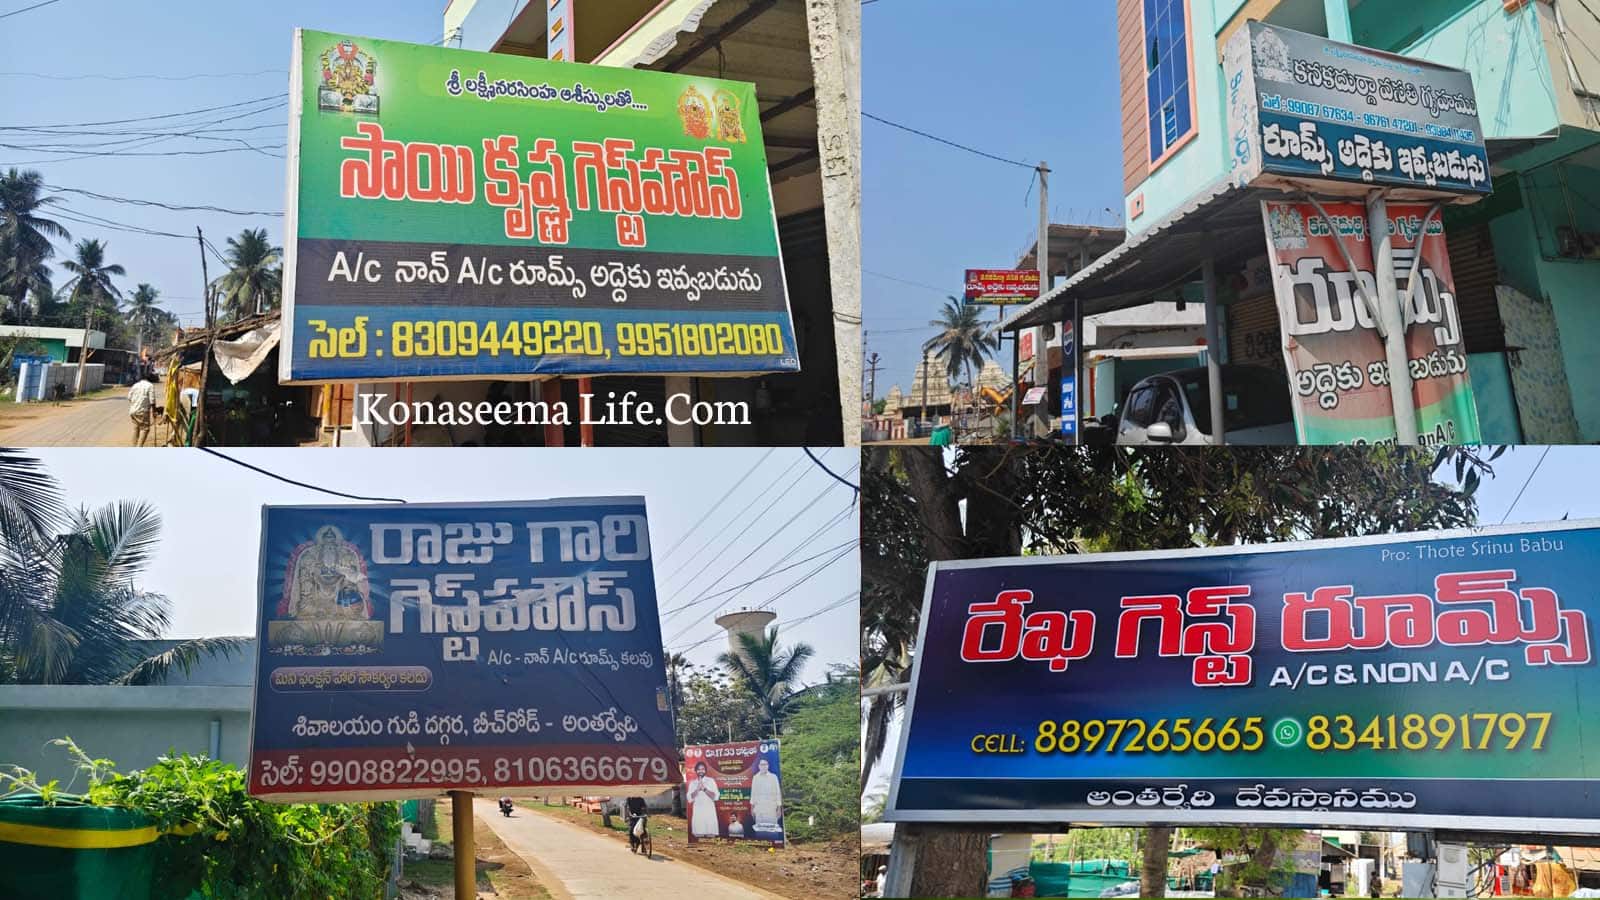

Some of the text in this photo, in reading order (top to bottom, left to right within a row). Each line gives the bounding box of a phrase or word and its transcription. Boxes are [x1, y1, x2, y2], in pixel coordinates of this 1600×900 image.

[446, 69, 463, 97] శ్రీ
[1378, 78, 1419, 106] వసతి
[1322, 103, 1354, 123] 67634
[1262, 121, 1487, 188] రూమ్స్ అద్దెకు ఇవ్వబడును
[340, 121, 475, 204] సాయి
[483, 134, 573, 245] కృష్ణ
[328, 251, 762, 302] A/c నాన్ A/c రూమ్స్ అద్దెకు ఇవ్వబడును
[308, 316, 369, 359] సెల్
[392, 320, 612, 360] 8309449220,
[616, 322, 784, 357] 9951802080
[1296, 360, 1363, 410] అద్దెకు
[369, 514, 650, 565] రాజు గారి
[1381, 537, 1565, 562] Pro: Thote Srinu Babu
[960, 568, 1593, 688] రేఖ గెస్ట్ రూమ్స్
[487, 649, 512, 666] A/c
[523, 647, 550, 665] నాన్
[552, 647, 578, 665] A/c
[579, 648, 620, 671] రూమ్స్
[1269, 656, 1510, 690] A/C & NON A/C
[292, 714, 384, 737] శివాలయం
[386, 710, 421, 735] గుడి
[425, 714, 469, 746] దగ్గర,
[562, 706, 638, 742] అంతర్వేది
[971, 712, 1553, 753] CELL: 8897265665 8341891797
[261, 755, 668, 787] సెల్: 9908822995, 8106366679
[1086, 783, 1216, 812] అంతర్వేది
